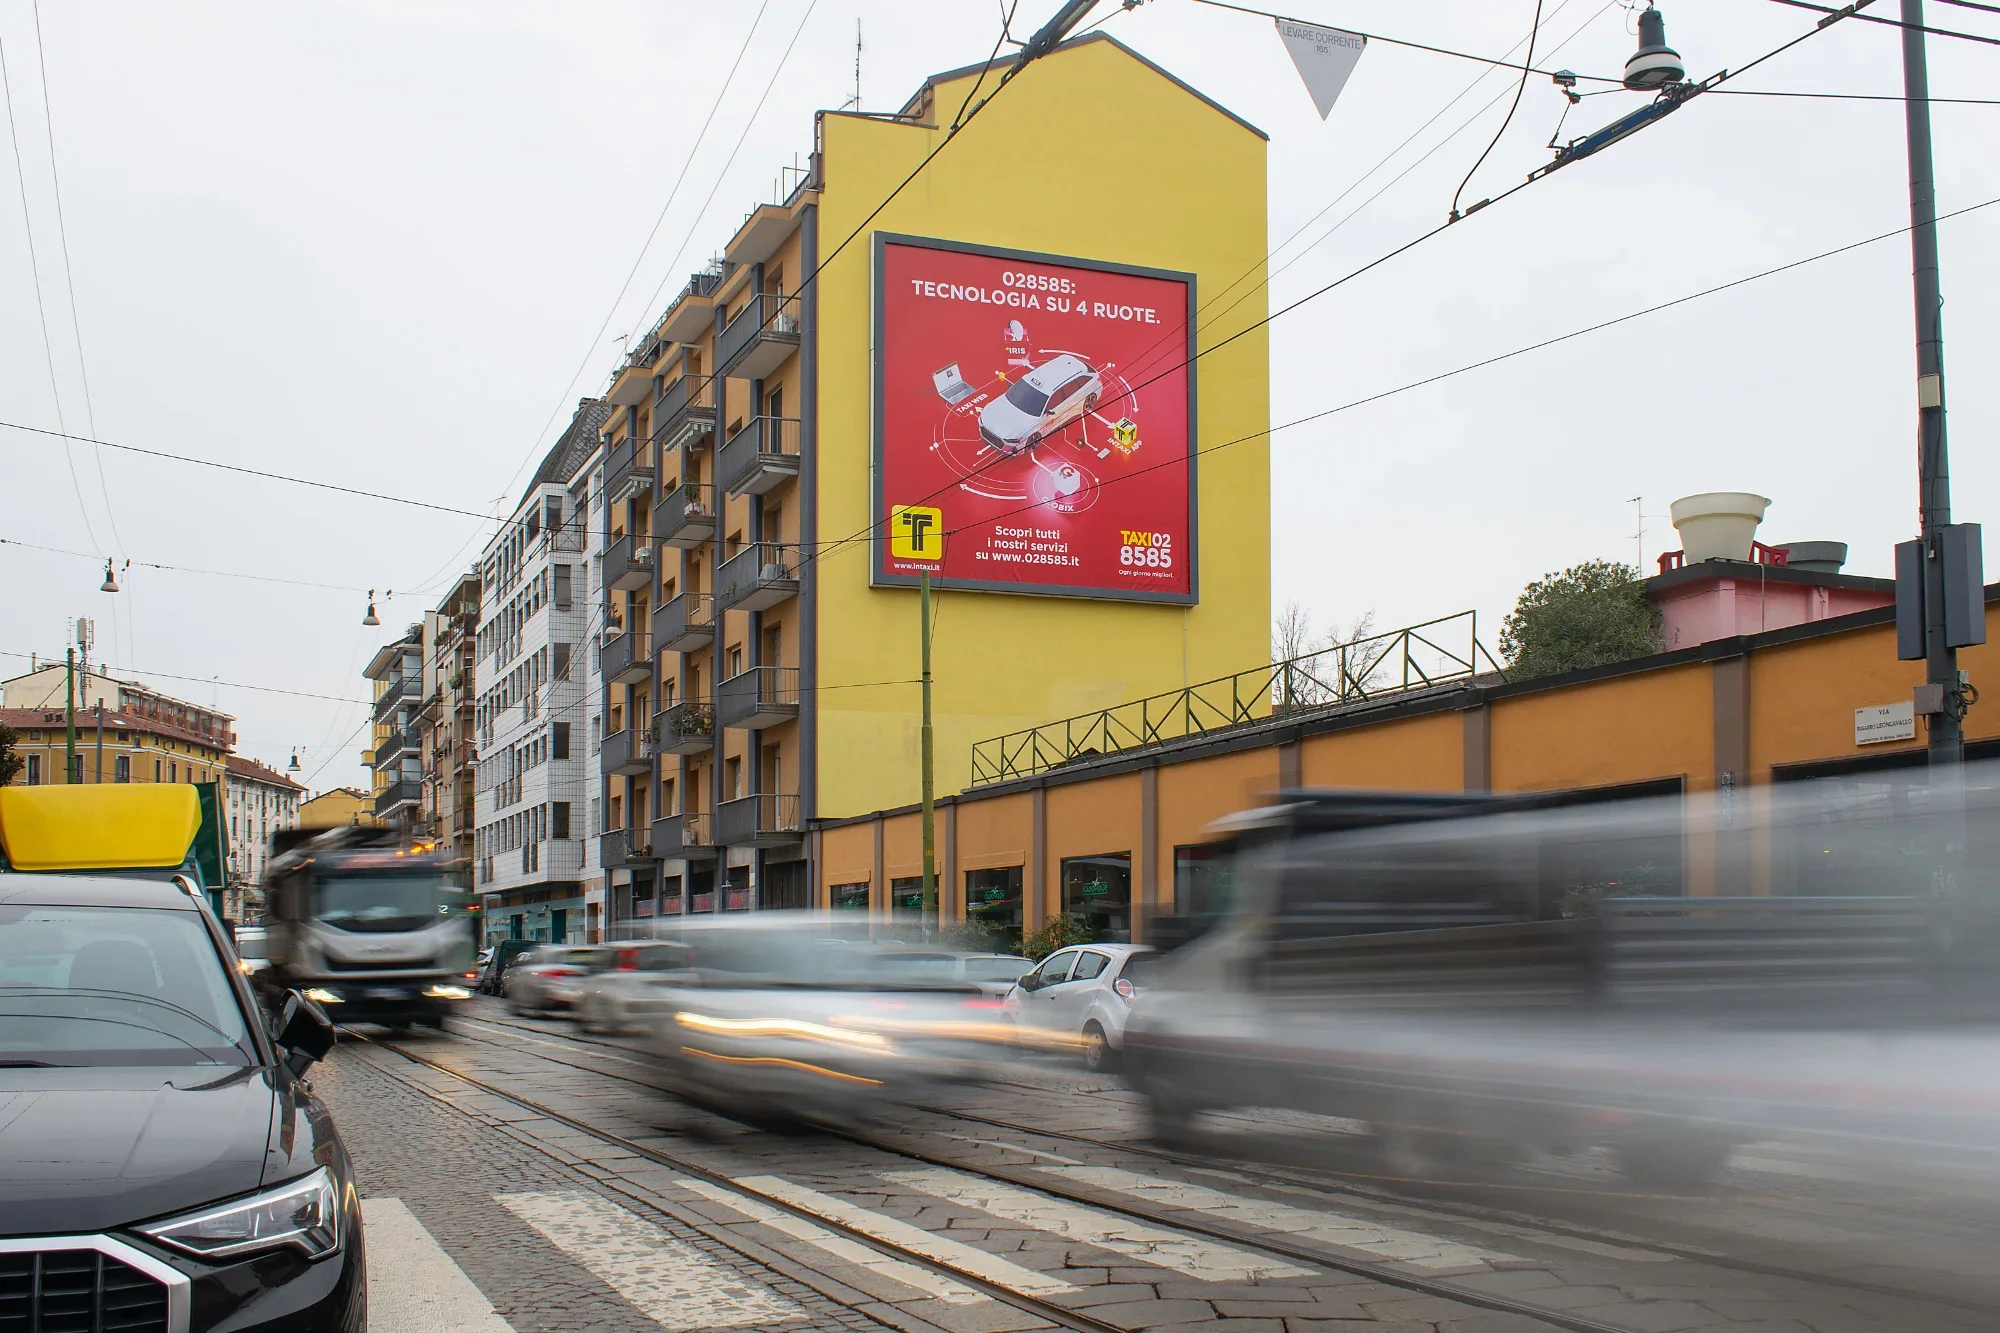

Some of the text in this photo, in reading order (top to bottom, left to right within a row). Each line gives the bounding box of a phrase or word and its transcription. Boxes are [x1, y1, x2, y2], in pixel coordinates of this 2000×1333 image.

[1282, 26, 1361, 49] LEVARE CORRENTE
[1316, 45, 1329, 54] 165
[1002, 271, 1076, 295] 028585:
[911, 279, 1161, 324] TECNOLOGIA SU 4 RUOTE.
[956, 393, 989, 413] TAXI WEB
[1107, 437, 1143, 455] INTAXI APP
[995, 525, 1060, 539] Scopri tutti
[987, 537, 1068, 553] i nostri servizi
[975, 551, 1080, 567] su www.028585.it
[1120, 545, 1172, 568] 8585
